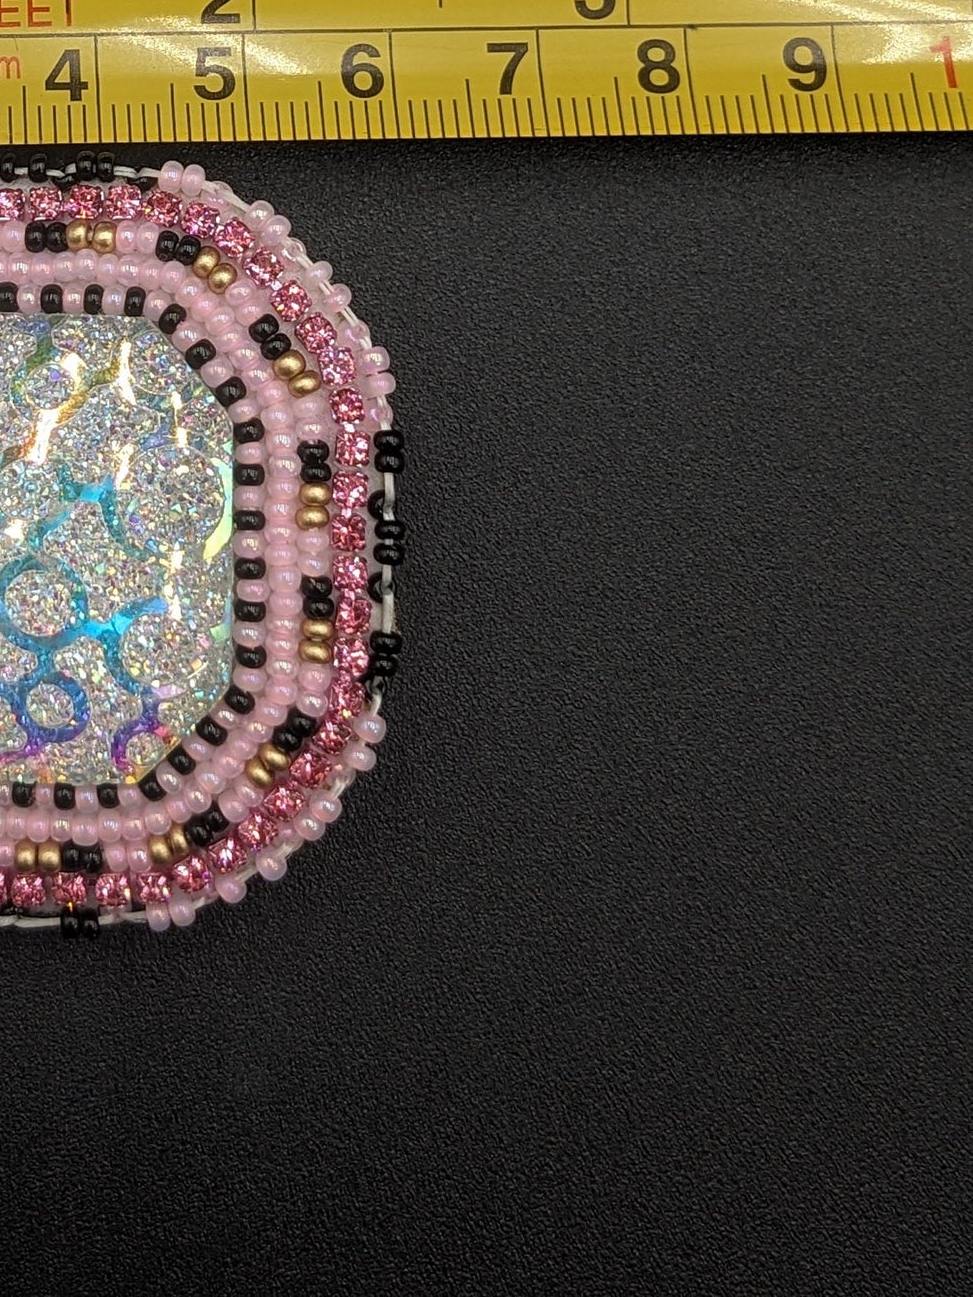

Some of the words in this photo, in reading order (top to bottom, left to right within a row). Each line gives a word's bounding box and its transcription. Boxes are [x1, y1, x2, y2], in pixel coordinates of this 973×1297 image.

[45, 49, 88, 102] 4
[193, 47, 235, 100] 5
[341, 44, 384, 97] 6
[486, 43, 529, 95] 7
[638, 39, 681, 94] 8
[783, 38, 827, 91] 9
